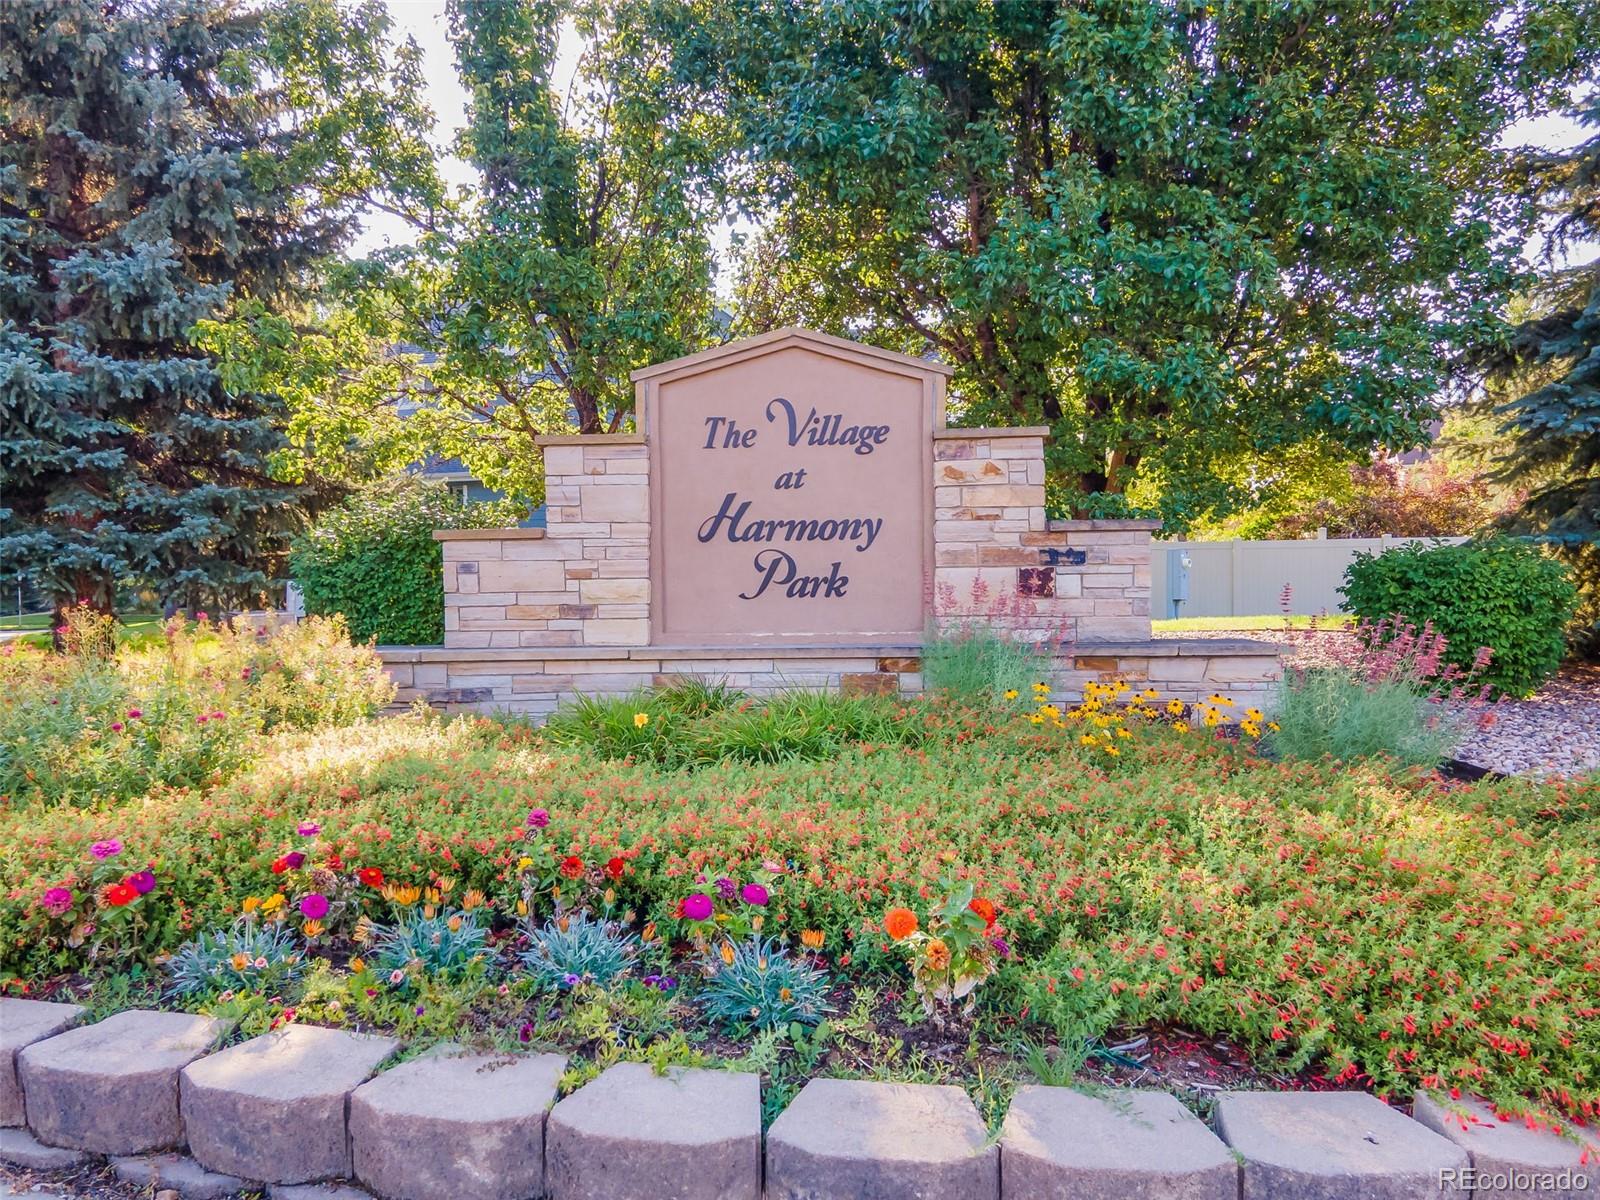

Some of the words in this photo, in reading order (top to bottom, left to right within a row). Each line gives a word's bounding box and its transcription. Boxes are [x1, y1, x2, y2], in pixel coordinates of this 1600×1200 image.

[702, 416, 757, 449] The
[766, 398, 890, 456] Village
[774, 468, 808, 490] at
[697, 492, 883, 552] Harmony
[738, 548, 849, 600] Park
